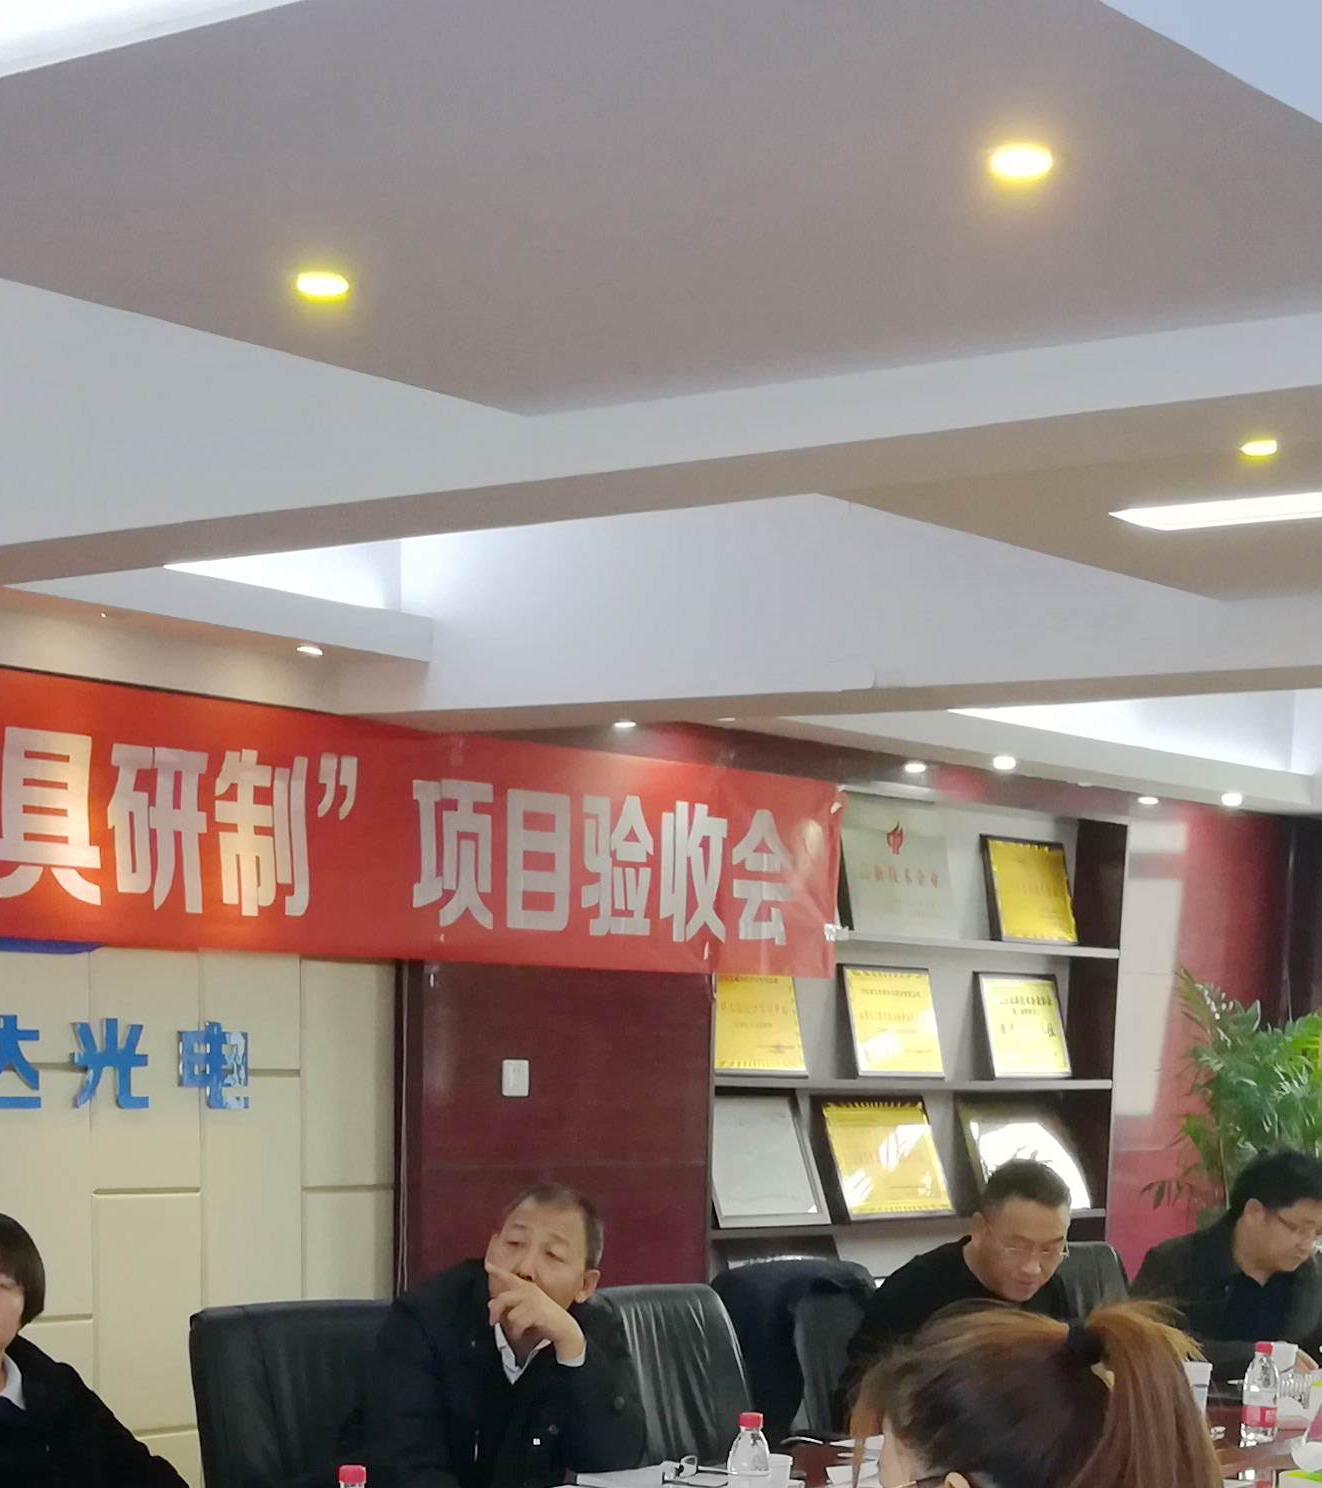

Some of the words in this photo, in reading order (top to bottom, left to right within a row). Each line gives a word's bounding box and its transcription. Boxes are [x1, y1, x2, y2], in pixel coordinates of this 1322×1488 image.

[412, 778, 793, 946] 项目验收会
